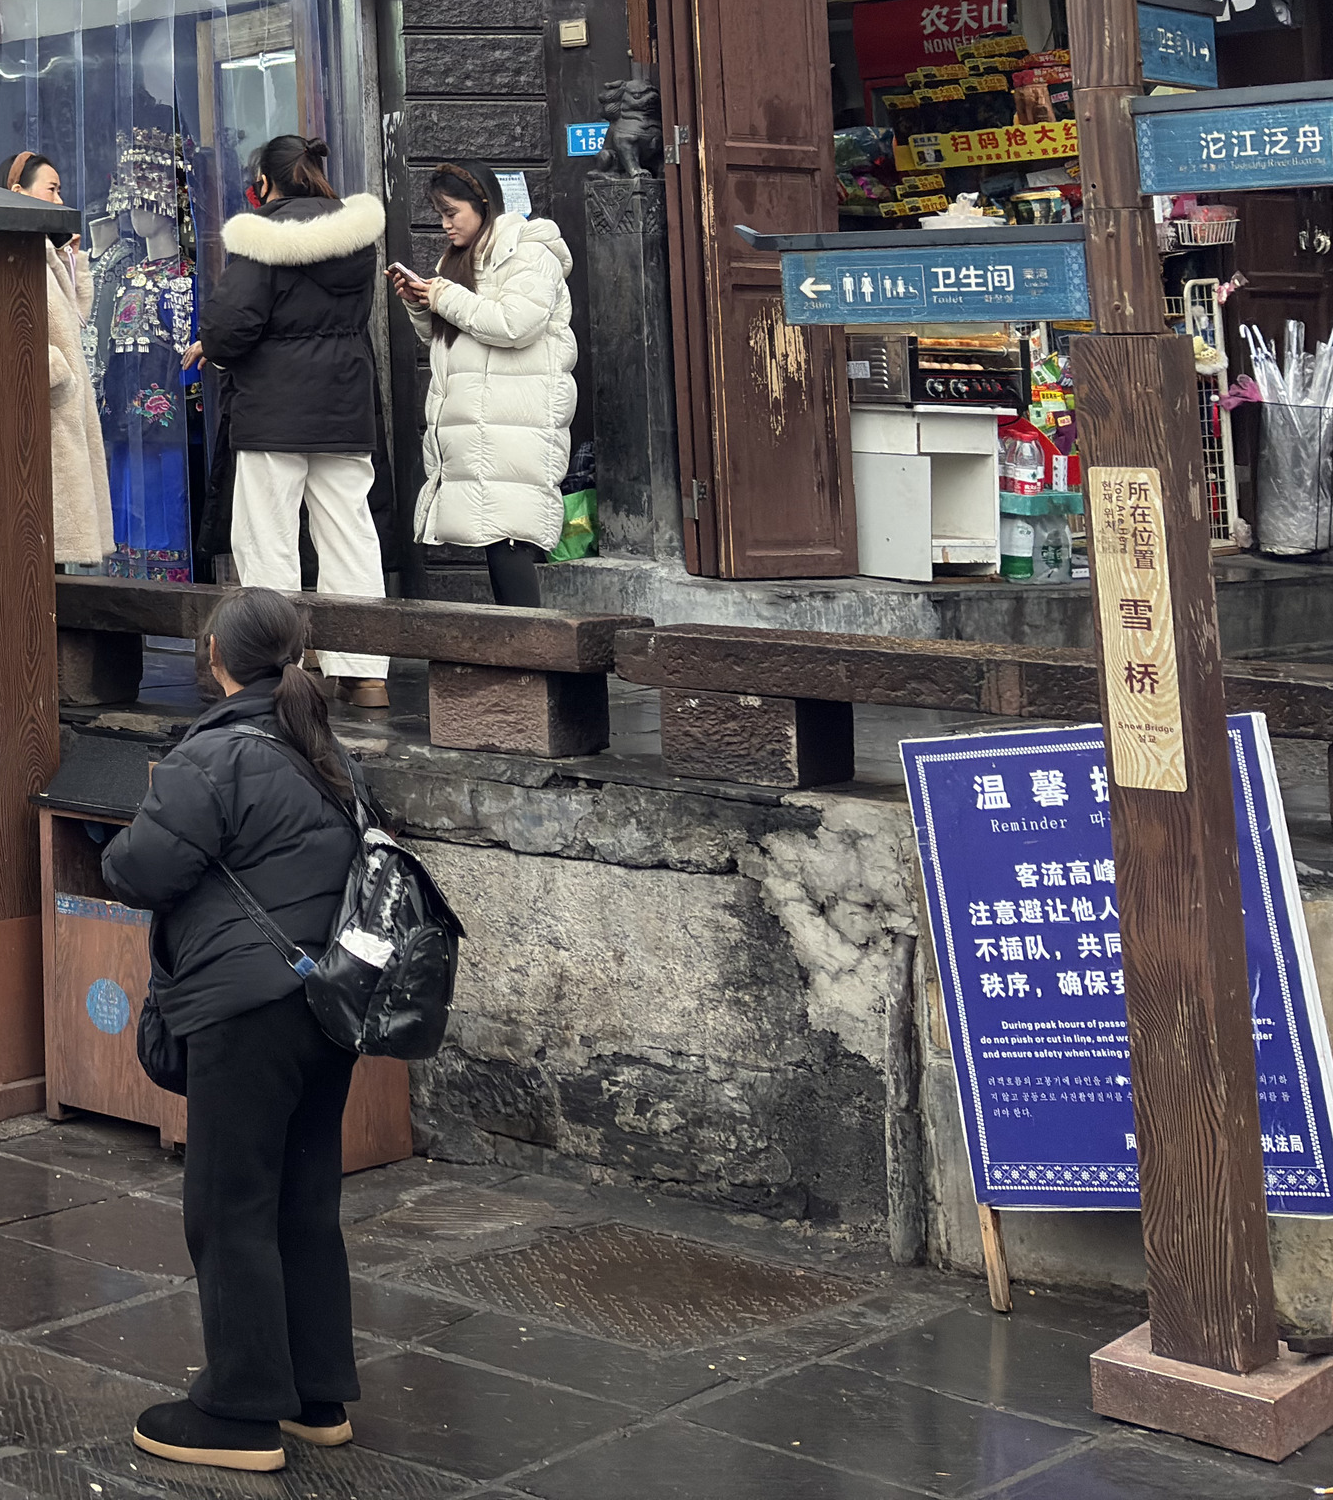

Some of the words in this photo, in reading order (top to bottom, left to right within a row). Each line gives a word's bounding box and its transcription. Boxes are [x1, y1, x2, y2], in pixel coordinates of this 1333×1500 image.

[579, 137, 605, 151] 158
[1200, 124, 1323, 159] 沱江泛舟
[931, 265, 1015, 292] 卫生间
[1114, 481, 1124, 499] You
[1116, 505, 1125, 524] Are
[1129, 482, 1156, 570] 所在位置
[1120, 598, 1160, 695] 雪桥
[1118, 721, 1142, 732] Snow
[1145, 722, 1174, 733] Bridge
[990, 816, 1068, 833] Reminder
[1015, 858, 1116, 888] 客流高峰
[968, 896, 1120, 926] 注意避让他人
[1001, 1020, 1033, 1031] During
[1034, 1020, 1057, 1031] peak
[1058, 1020, 1085, 1029] hours
[1087, 1019, 1097, 1028] of
[1098, 1020, 1128, 1030] passe
[980, 1036, 992, 1044] do
[993, 1036, 1010, 1044] not
[1011, 1035, 1033, 1046] push
[1035, 1036, 1045, 1044] or
[1046, 1035, 1062, 1043] cut
[1063, 1034, 1072, 1043] in
[1096, 1034, 1115, 1043] and
[982, 1050, 1000, 1059] and
[1034, 1049, 1063, 1059] safety
[1064, 1049, 1091, 1058] when
[1091, 1049, 1123, 1059] taking
